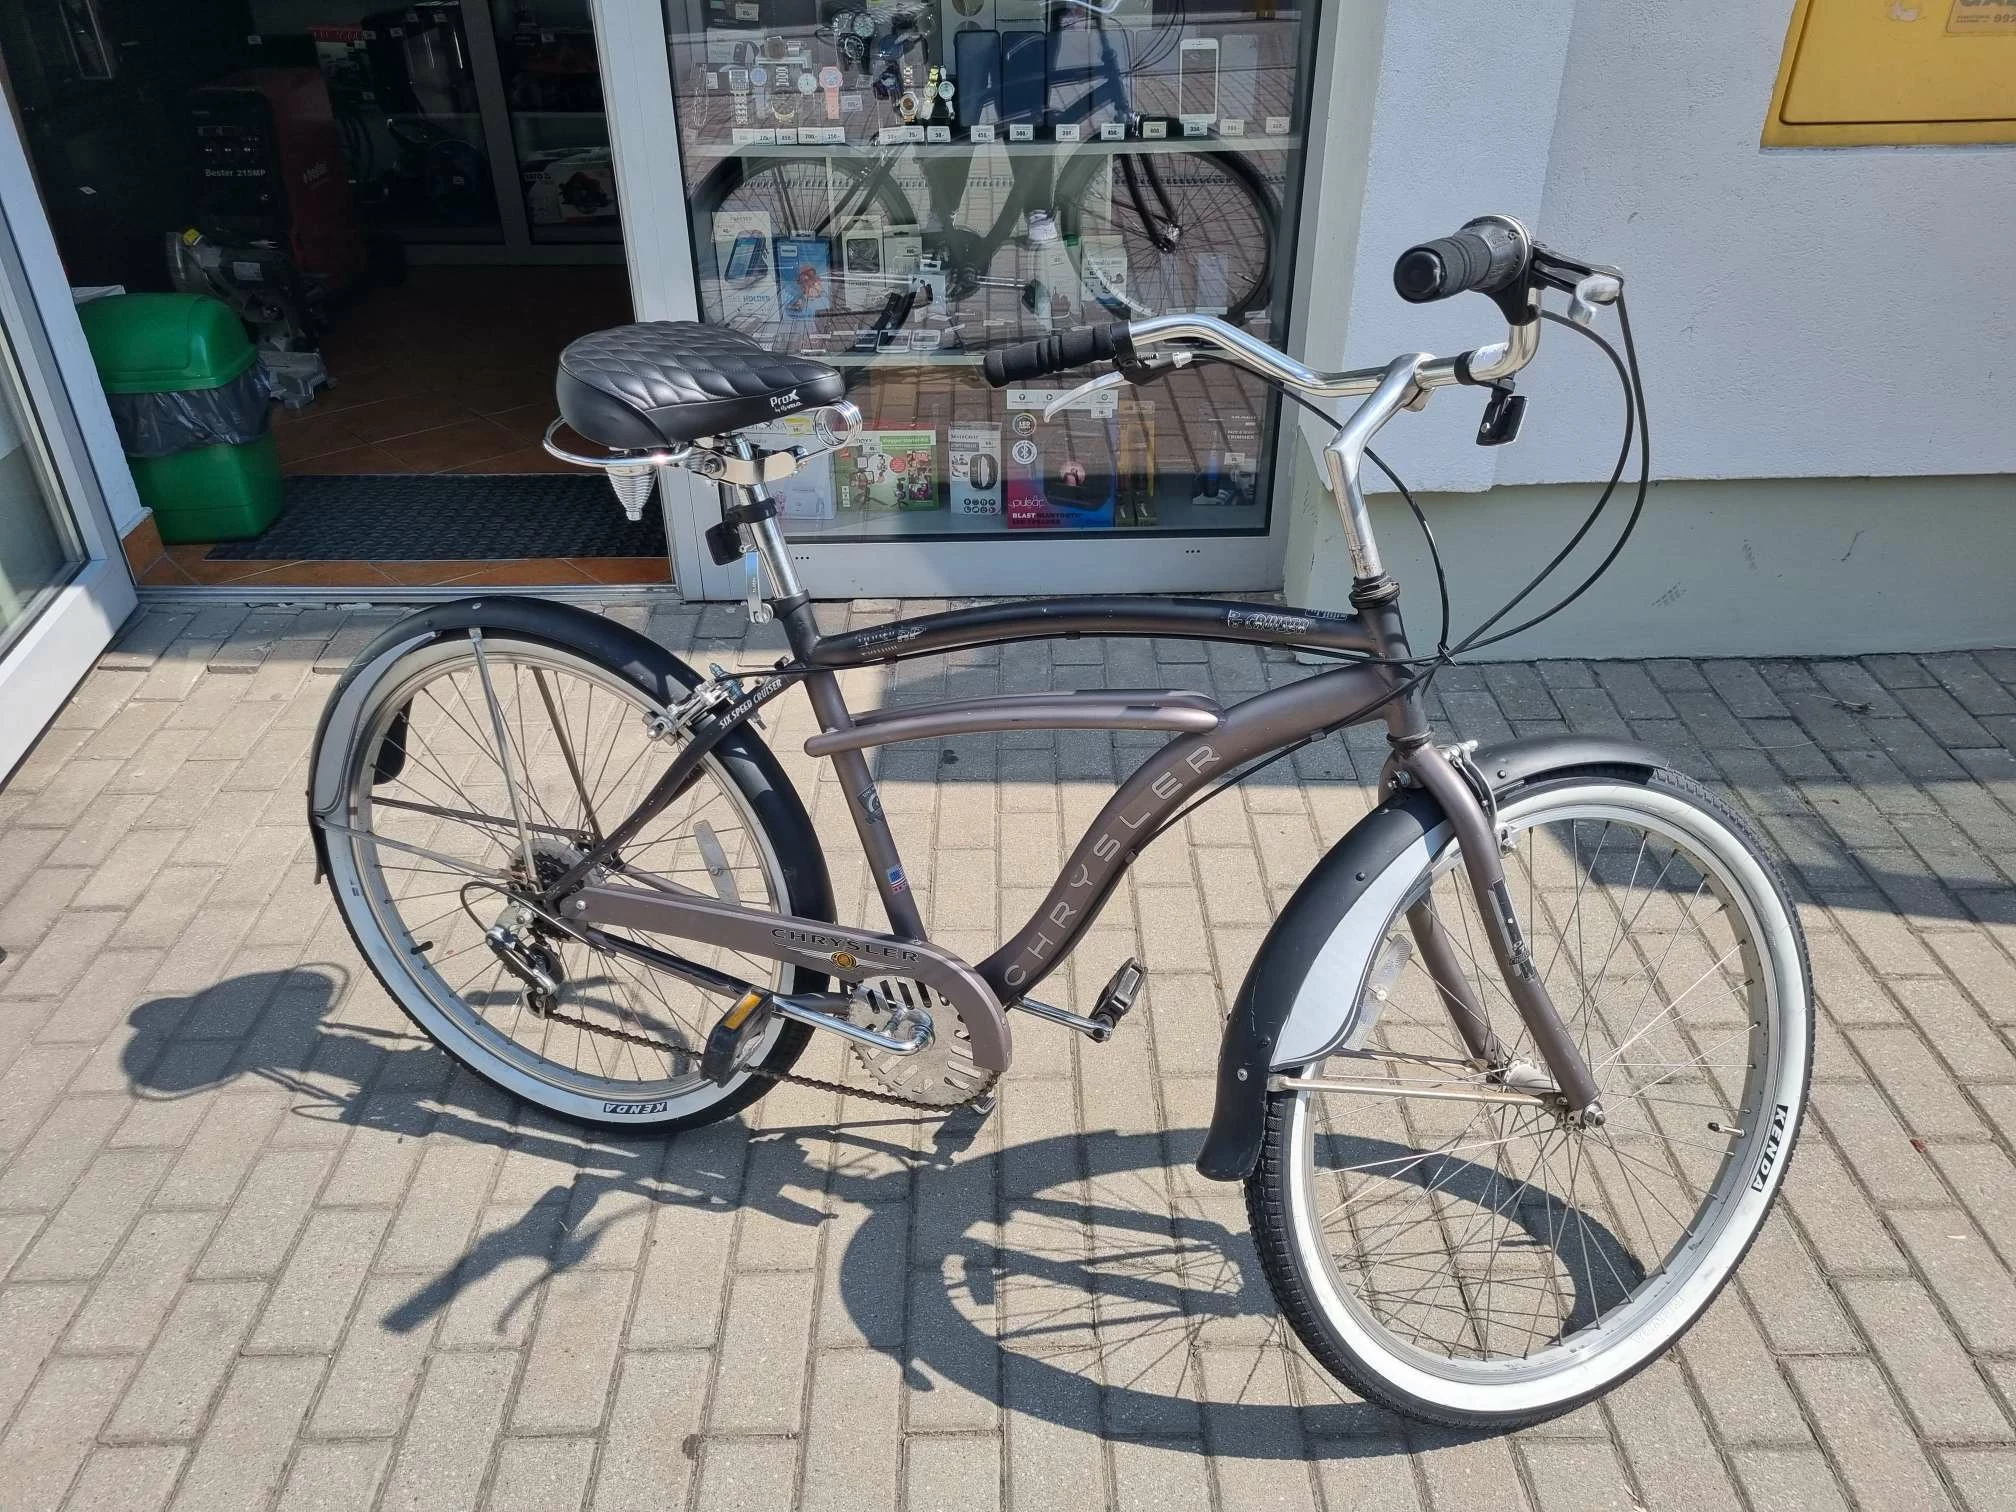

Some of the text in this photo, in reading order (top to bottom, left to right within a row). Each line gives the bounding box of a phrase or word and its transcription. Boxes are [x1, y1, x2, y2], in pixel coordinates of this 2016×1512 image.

[719, 678, 783, 730] SIX SPEED CRUISER
[1003, 745, 1221, 987] CHRYSLER
[771, 928, 920, 964] CHRYSLER
[604, 1101, 667, 1115] KENDA
[1753, 1105, 1788, 1191] KENDA
